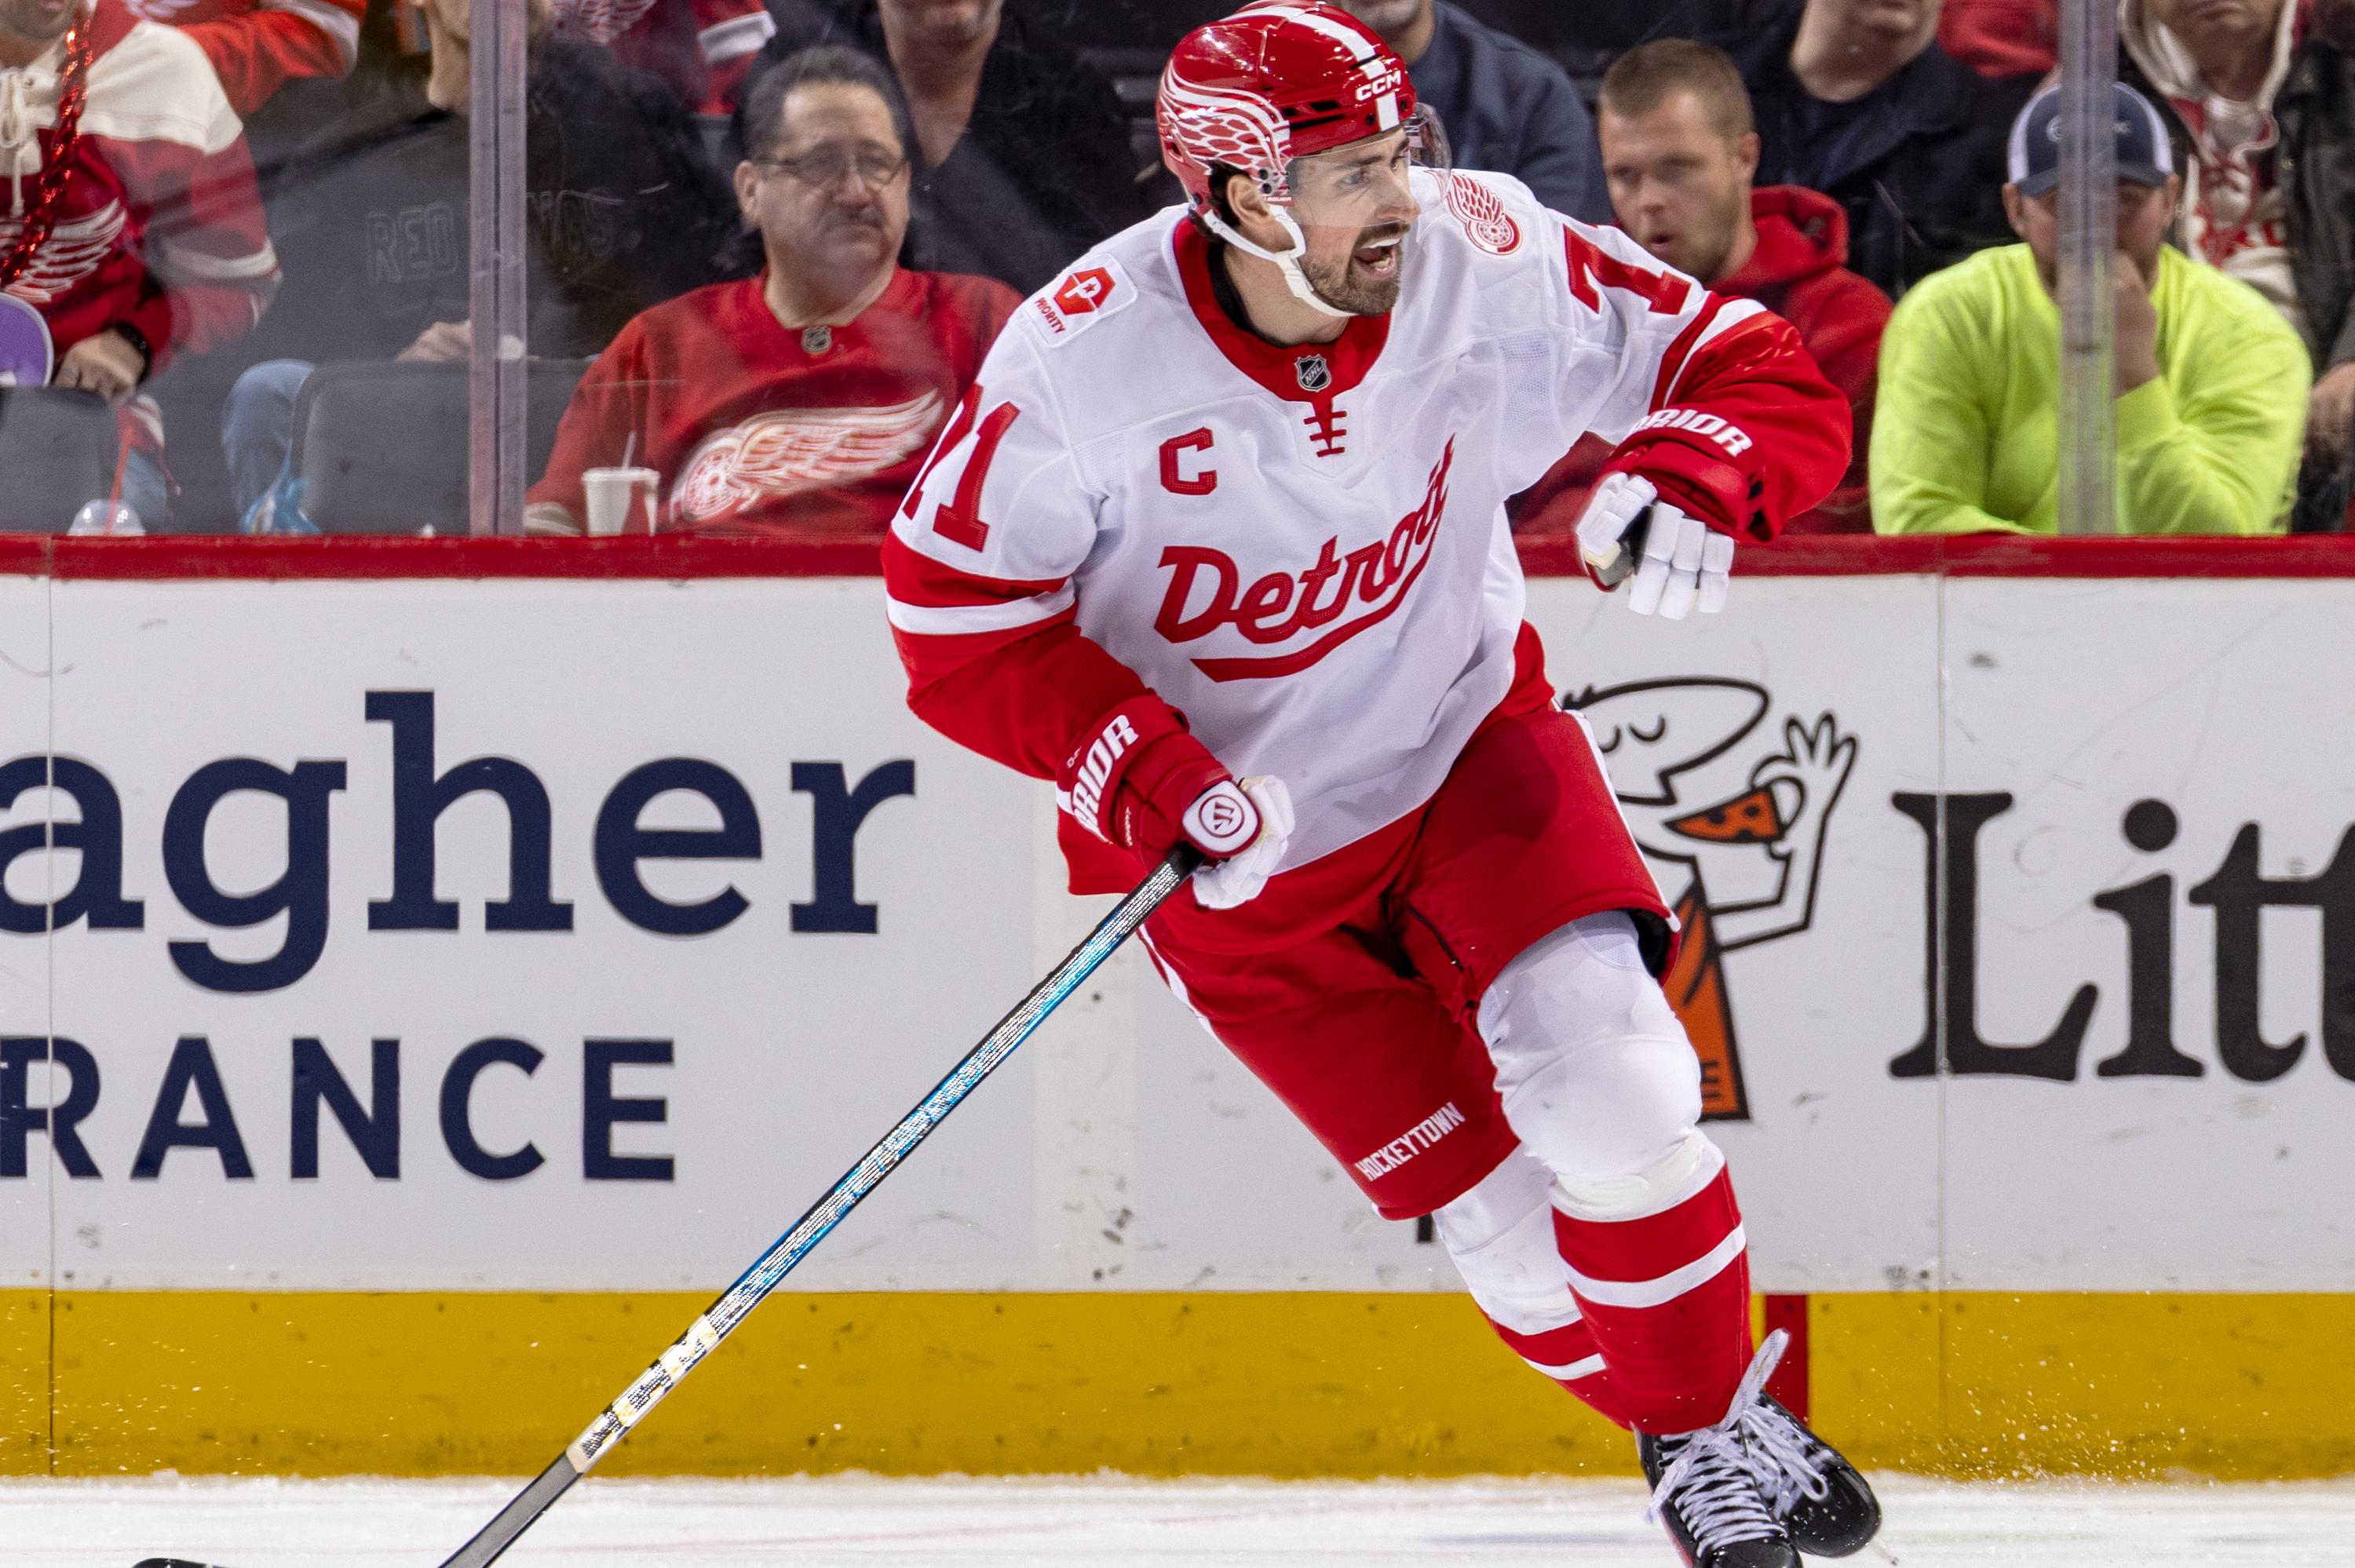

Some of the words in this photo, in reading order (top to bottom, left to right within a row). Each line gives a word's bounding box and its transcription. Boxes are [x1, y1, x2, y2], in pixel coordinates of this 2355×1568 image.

[1355, 70, 1401, 101] CCM
[365, 201, 458, 283] RED
[1305, 363, 1322, 385] NHL
[1159, 427, 1218, 496] C
[1153, 432, 1456, 644] Detroit
[0, 688, 916, 994] agher
[0, 1034, 675, 1181] RANCE
[1354, 1101, 1466, 1182] HOCKEYTOWN
